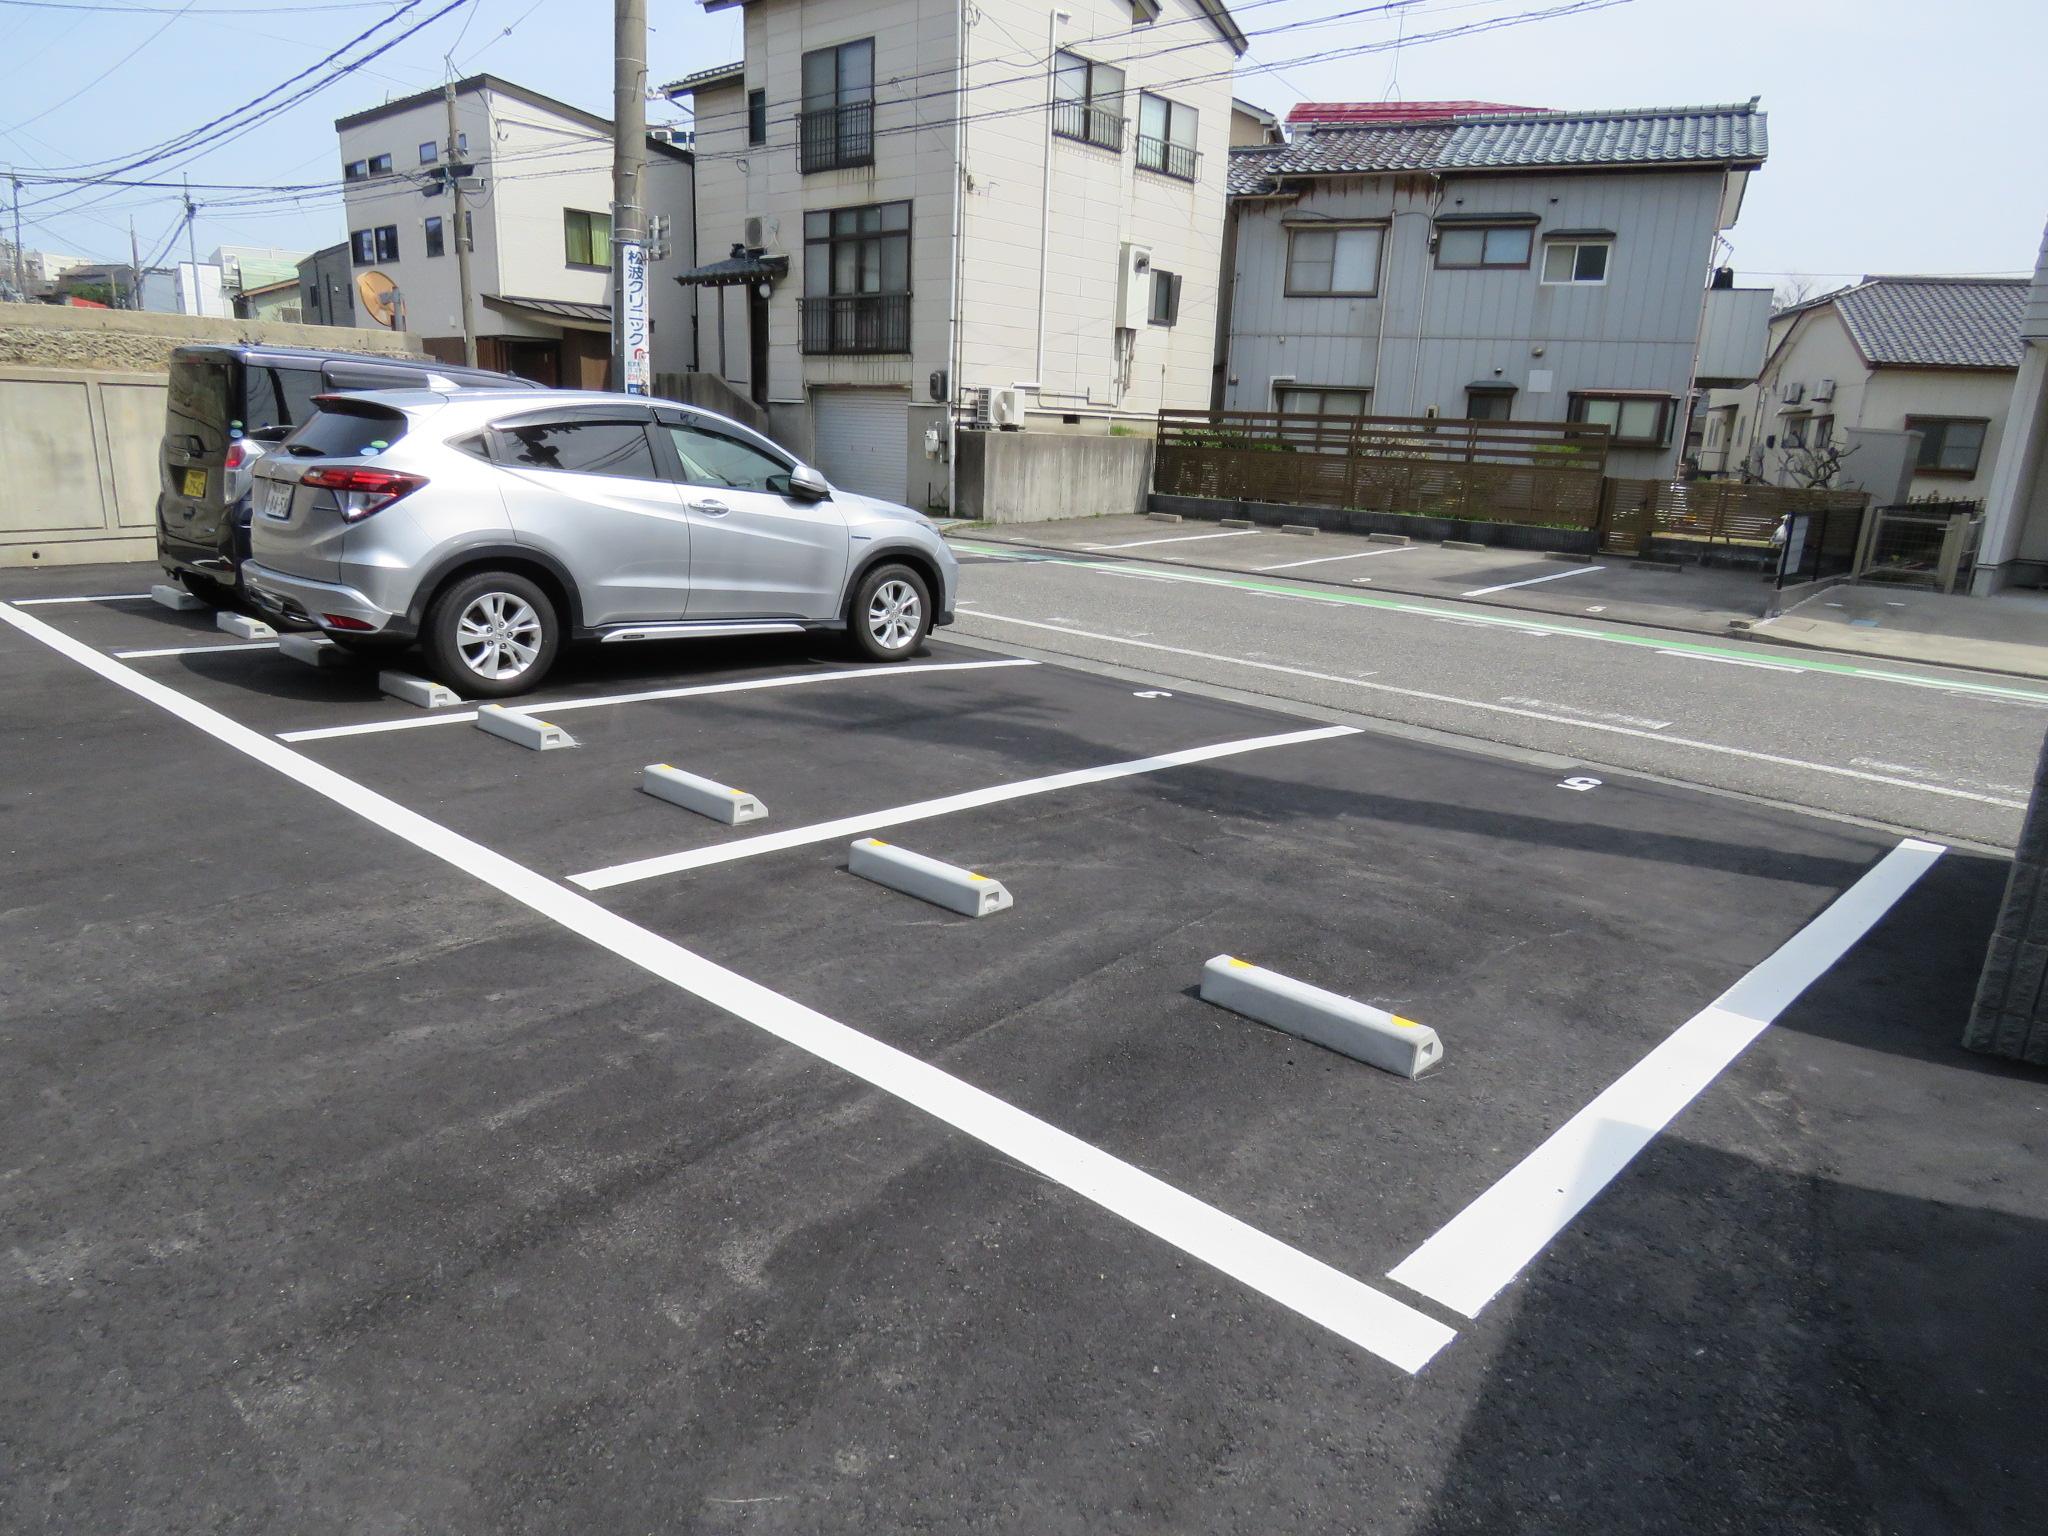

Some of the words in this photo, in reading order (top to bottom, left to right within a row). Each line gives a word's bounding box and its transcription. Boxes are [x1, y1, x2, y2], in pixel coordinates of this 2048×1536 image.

[628, 250, 644, 346] 松波クリニック
[1556, 776, 1603, 791] 5
